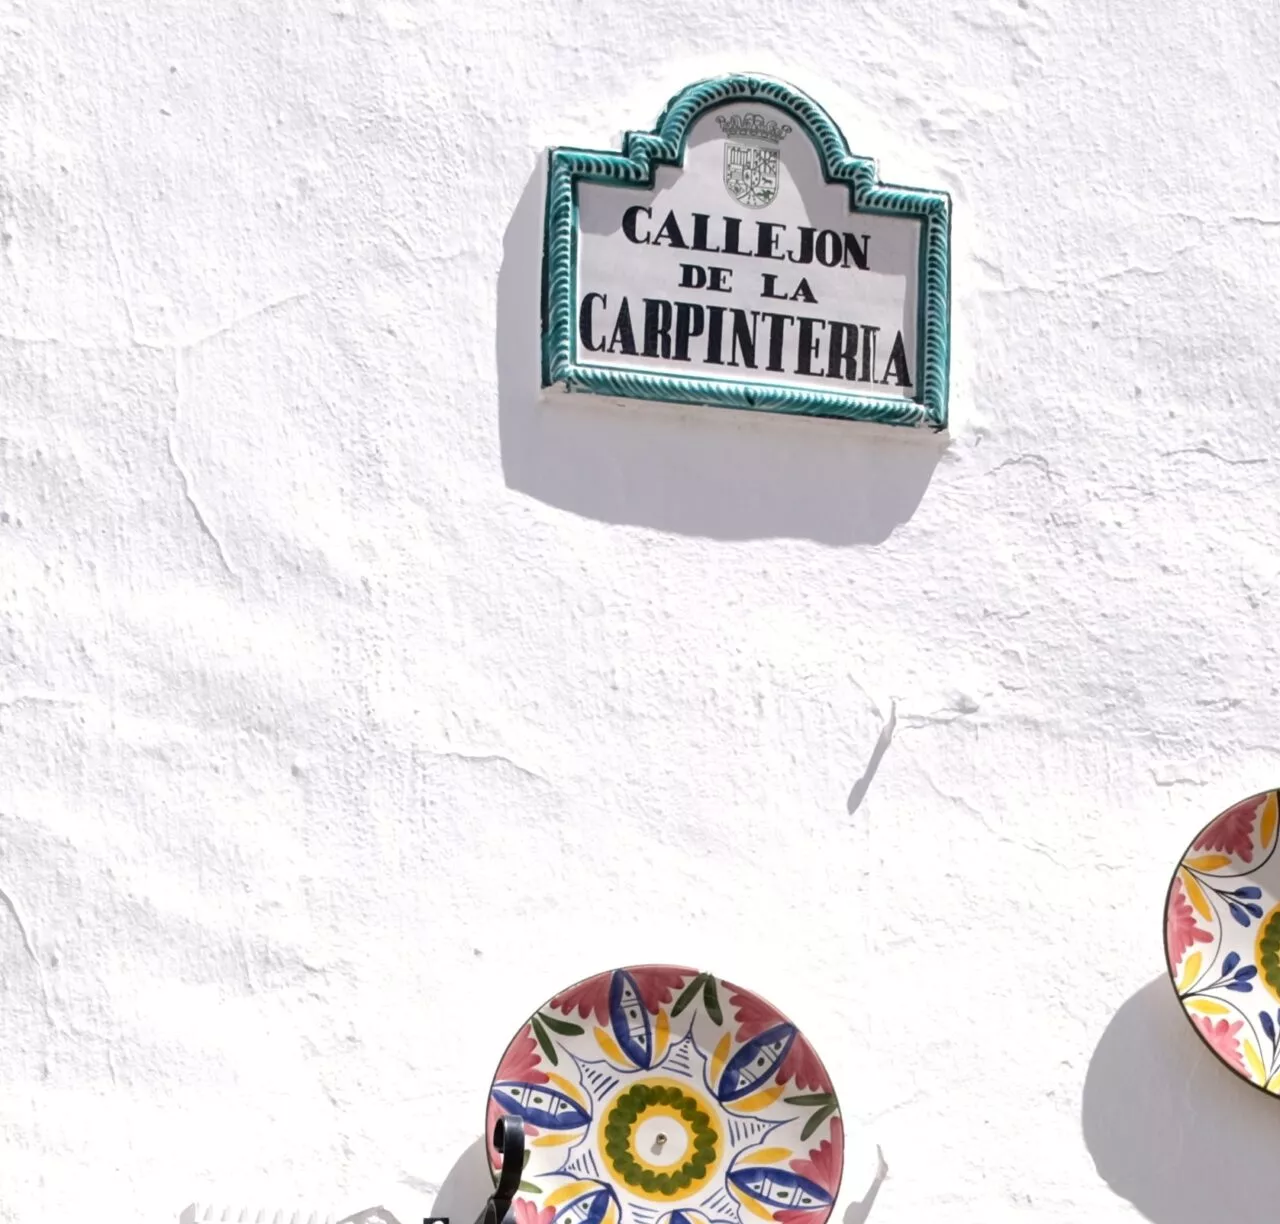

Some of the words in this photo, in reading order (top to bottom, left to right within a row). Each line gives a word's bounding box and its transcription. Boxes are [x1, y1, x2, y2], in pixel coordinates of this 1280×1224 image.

[622, 205, 871, 270] CALLEJON
[678, 263, 733, 293] DE
[760, 272, 818, 304] LA
[579, 292, 913, 388] CARPINTERIA
